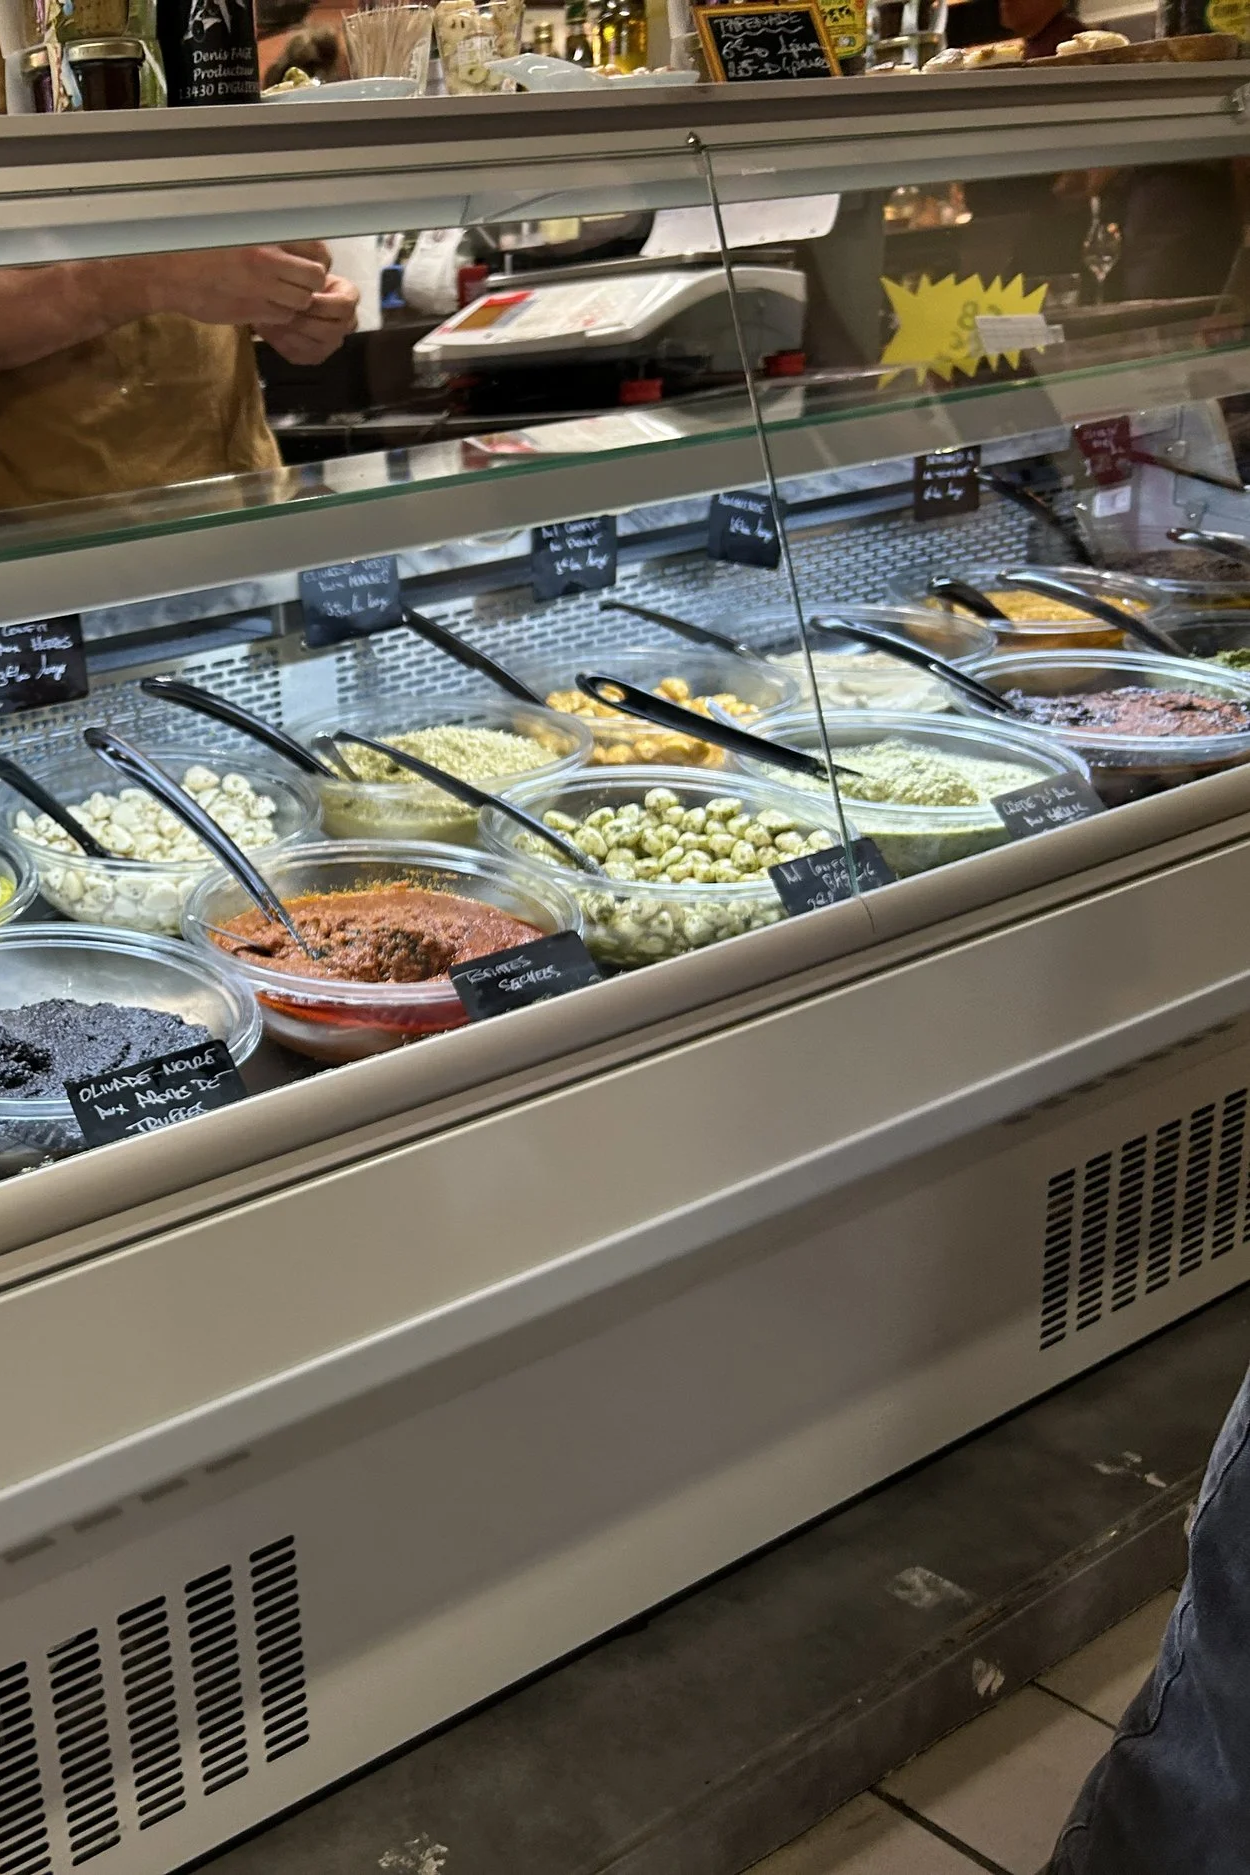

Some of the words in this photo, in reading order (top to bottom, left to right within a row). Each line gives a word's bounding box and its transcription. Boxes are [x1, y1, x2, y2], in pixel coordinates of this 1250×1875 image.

[192, 50, 228, 64] Denis
[179, 82, 215, 100] 13430
[190, 1068, 235, 1093] DE
